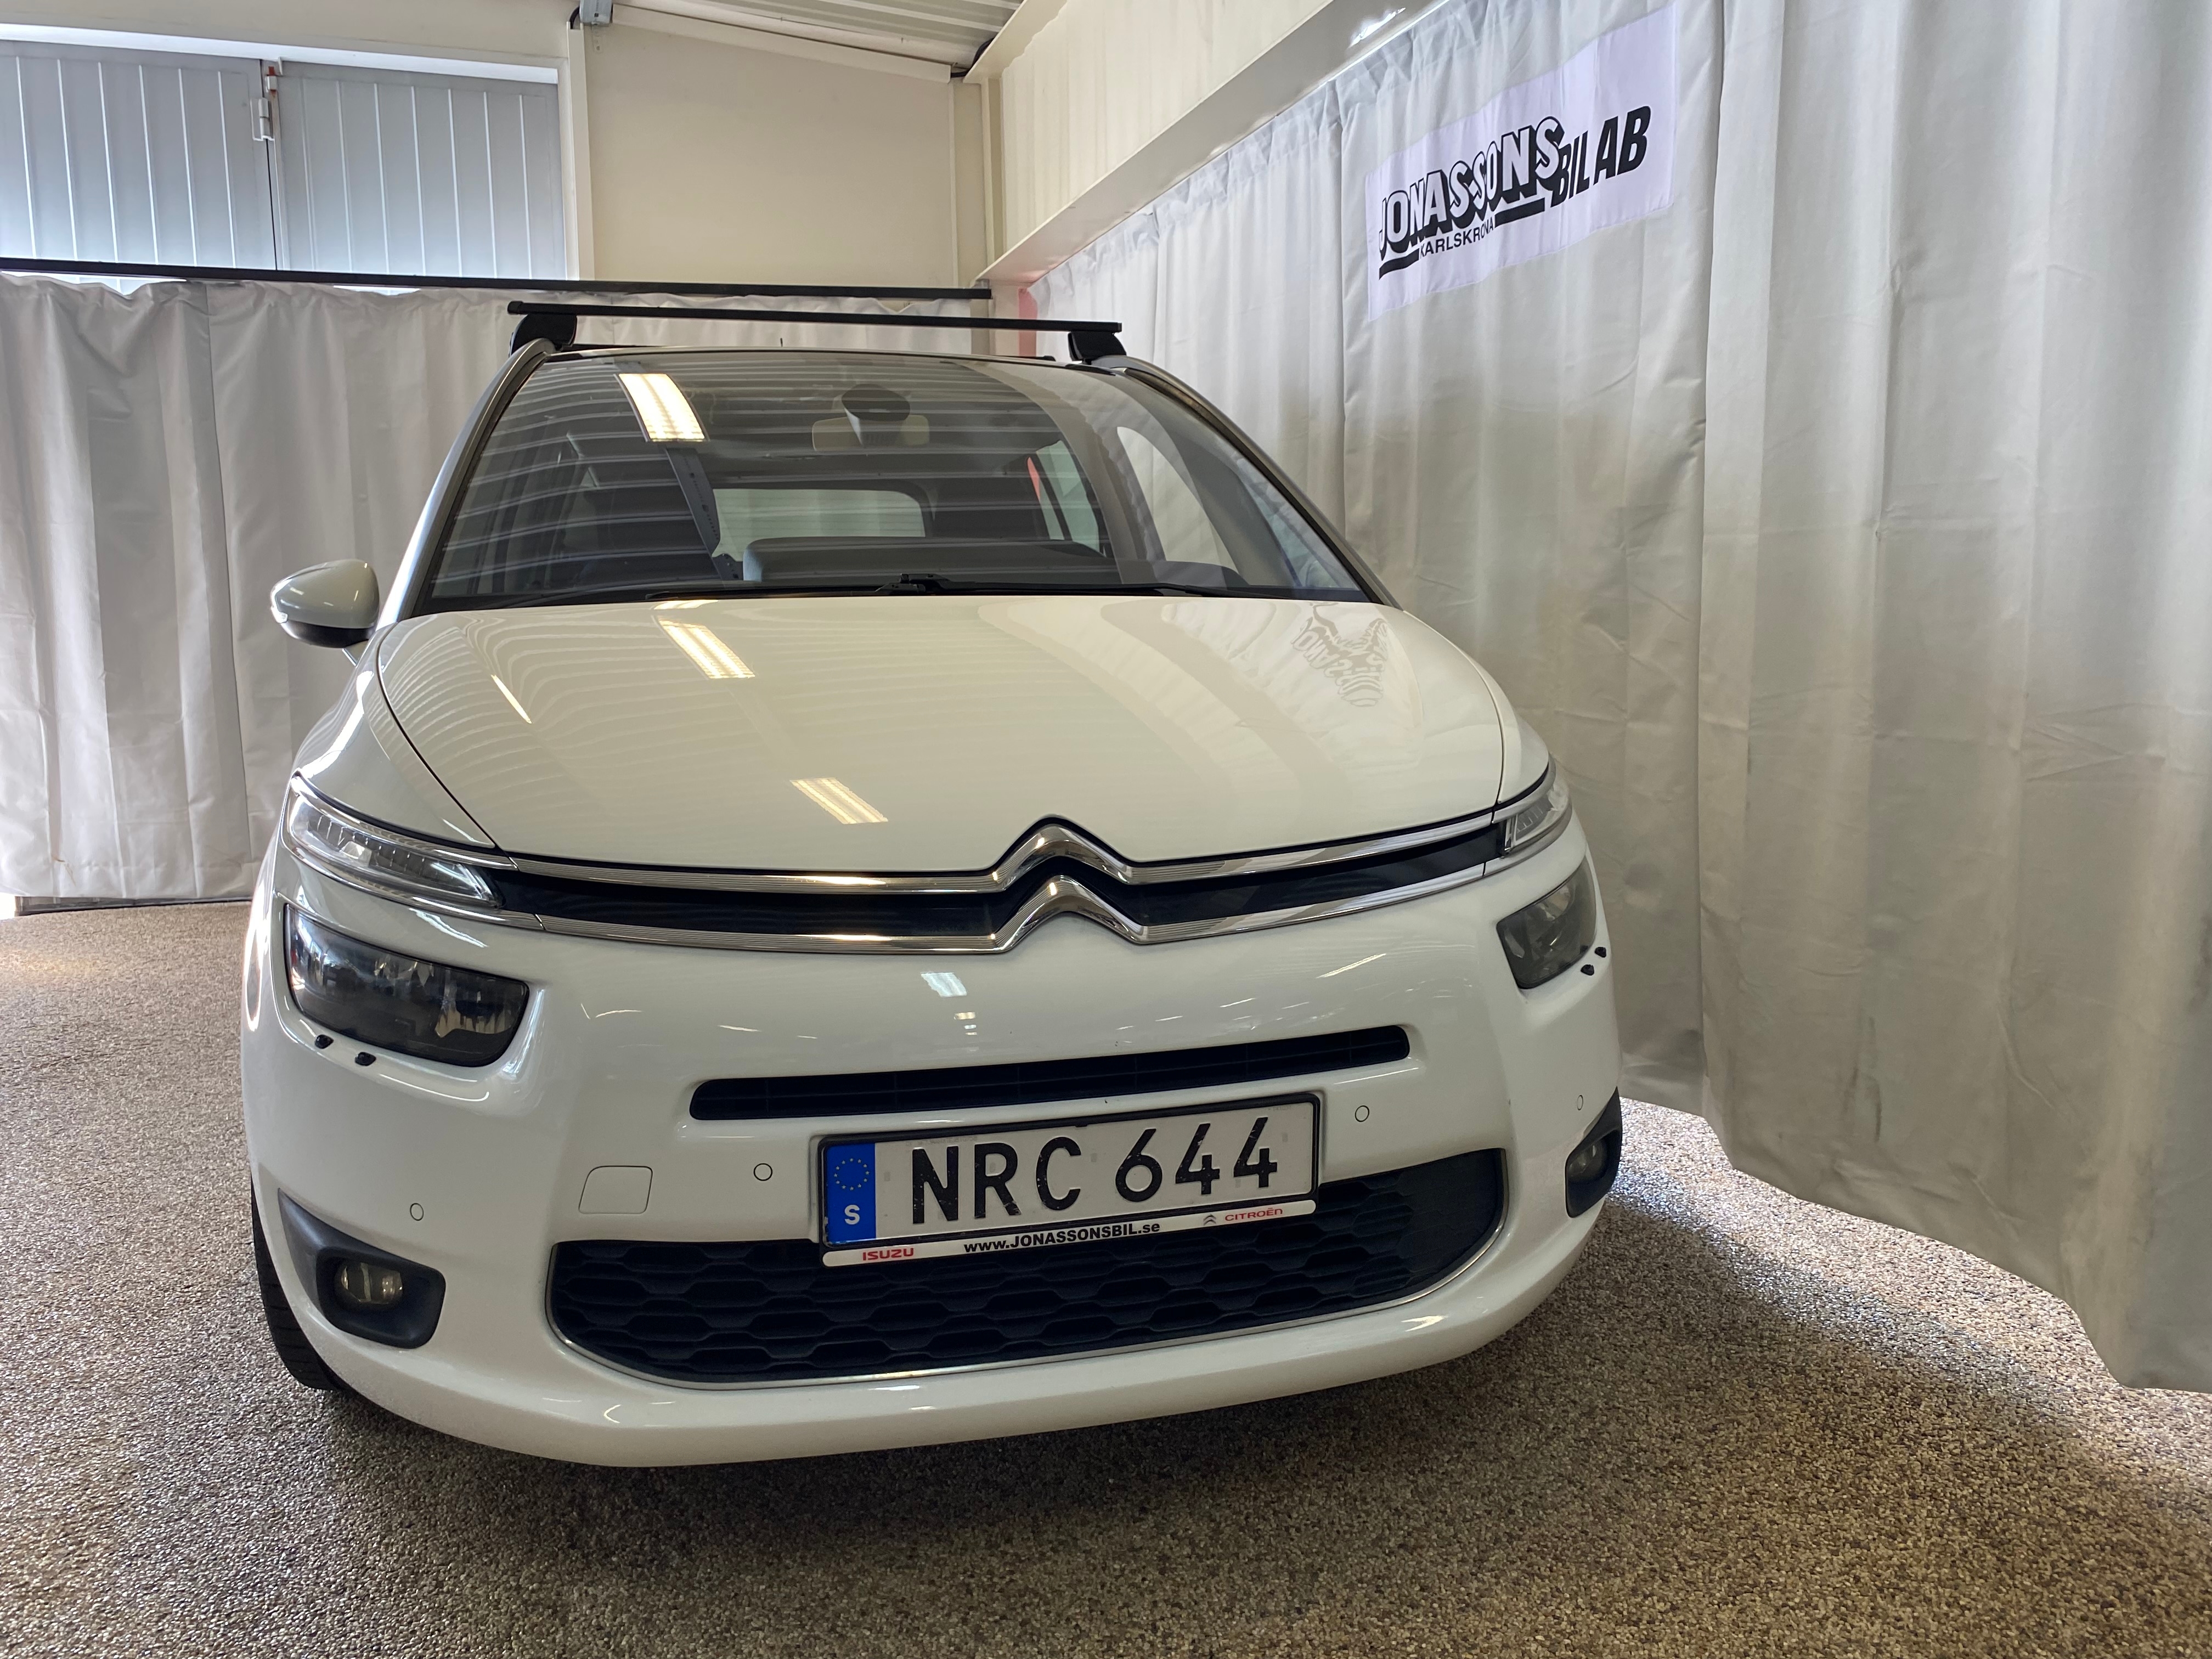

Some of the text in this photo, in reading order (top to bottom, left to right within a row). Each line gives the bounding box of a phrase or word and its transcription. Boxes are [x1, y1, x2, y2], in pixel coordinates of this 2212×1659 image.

[1379, 106, 1651, 261] JONASSONS BIL AB
[912, 1116, 1278, 1224] NRC 644
[844, 1204, 860, 1225] S
[963, 1222, 1160, 1253] www.JONASSONSBIL.se
[862, 1247, 915, 1261] ISUZU
